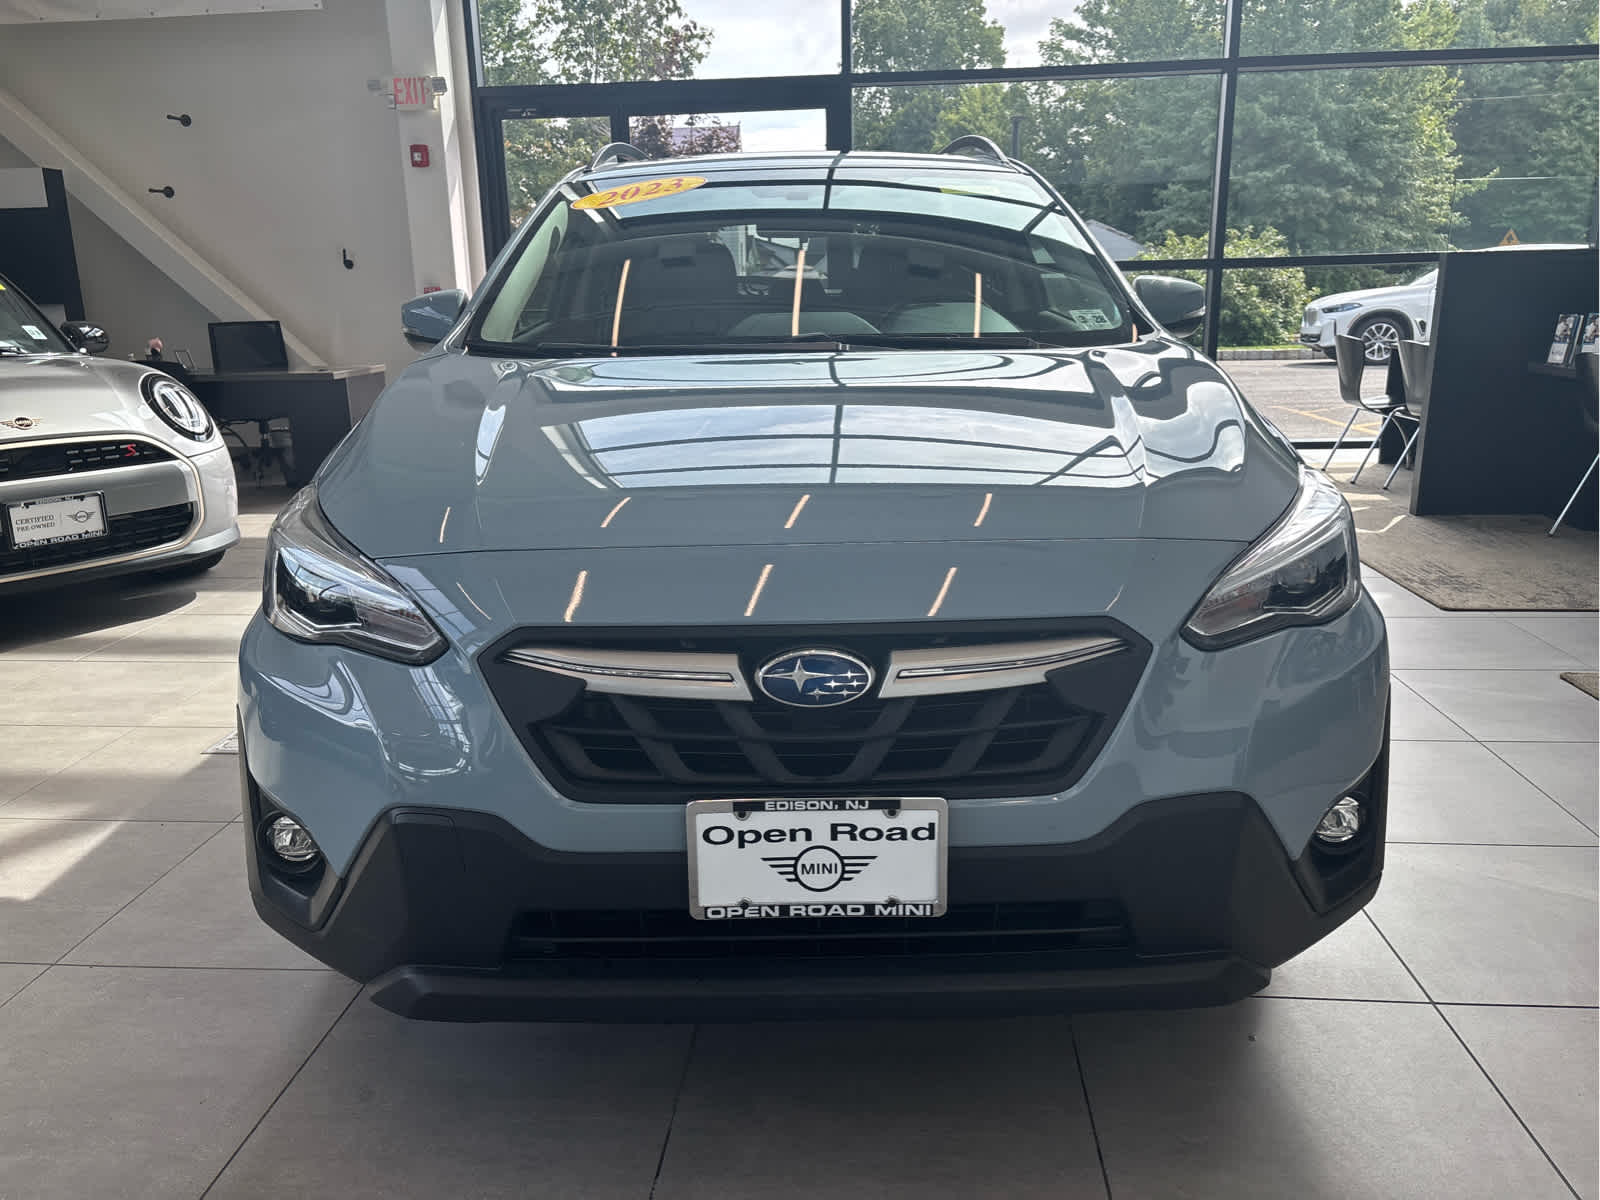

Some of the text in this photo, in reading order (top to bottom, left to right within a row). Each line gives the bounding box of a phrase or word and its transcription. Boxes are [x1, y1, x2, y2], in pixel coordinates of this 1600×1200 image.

[392, 77, 426, 105] EXIT
[599, 178, 684, 206] 2023
[15, 515, 55, 526] CERTIFIED
[50, 534, 79, 544] ROAD
[764, 800, 869, 811] EDISON, NJ
[702, 822, 936, 849] Open Road
[801, 863, 838, 876] MINI
[706, 904, 931, 919] OPEN ROAD MINI
